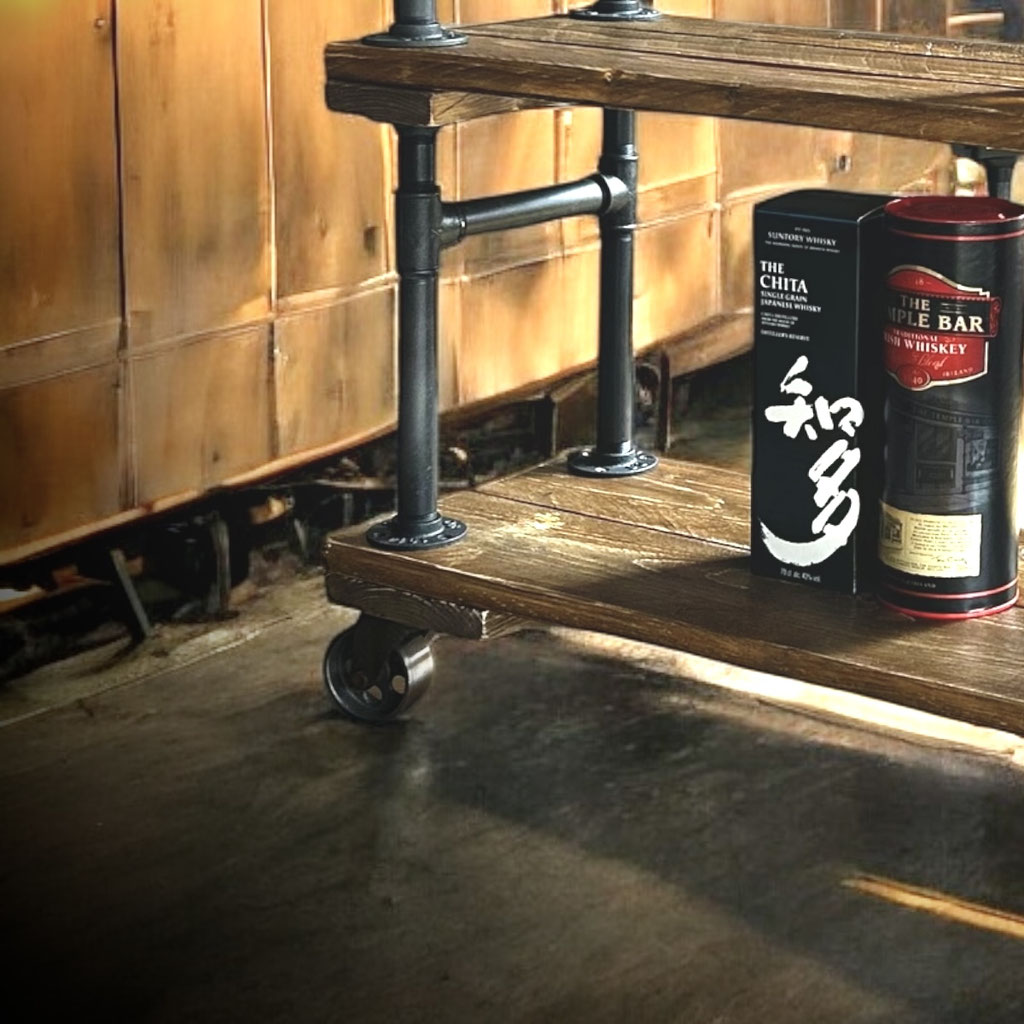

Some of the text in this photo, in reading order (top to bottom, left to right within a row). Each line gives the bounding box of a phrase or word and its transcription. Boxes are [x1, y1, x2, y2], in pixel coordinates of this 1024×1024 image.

[767, 230, 804, 242] SUNTORY
[805, 236, 837, 247] WHISKY
[759, 260, 785, 275] THE
[759, 274, 809, 294] CHITA
[760, 290, 808, 303] SINGLE GRAIN
[900, 295, 931, 312] THE
[760, 298, 822, 313] JAPANESE WHISKY
[937, 314, 985, 333] BAR
[903, 338, 968, 355] WHISKEY
